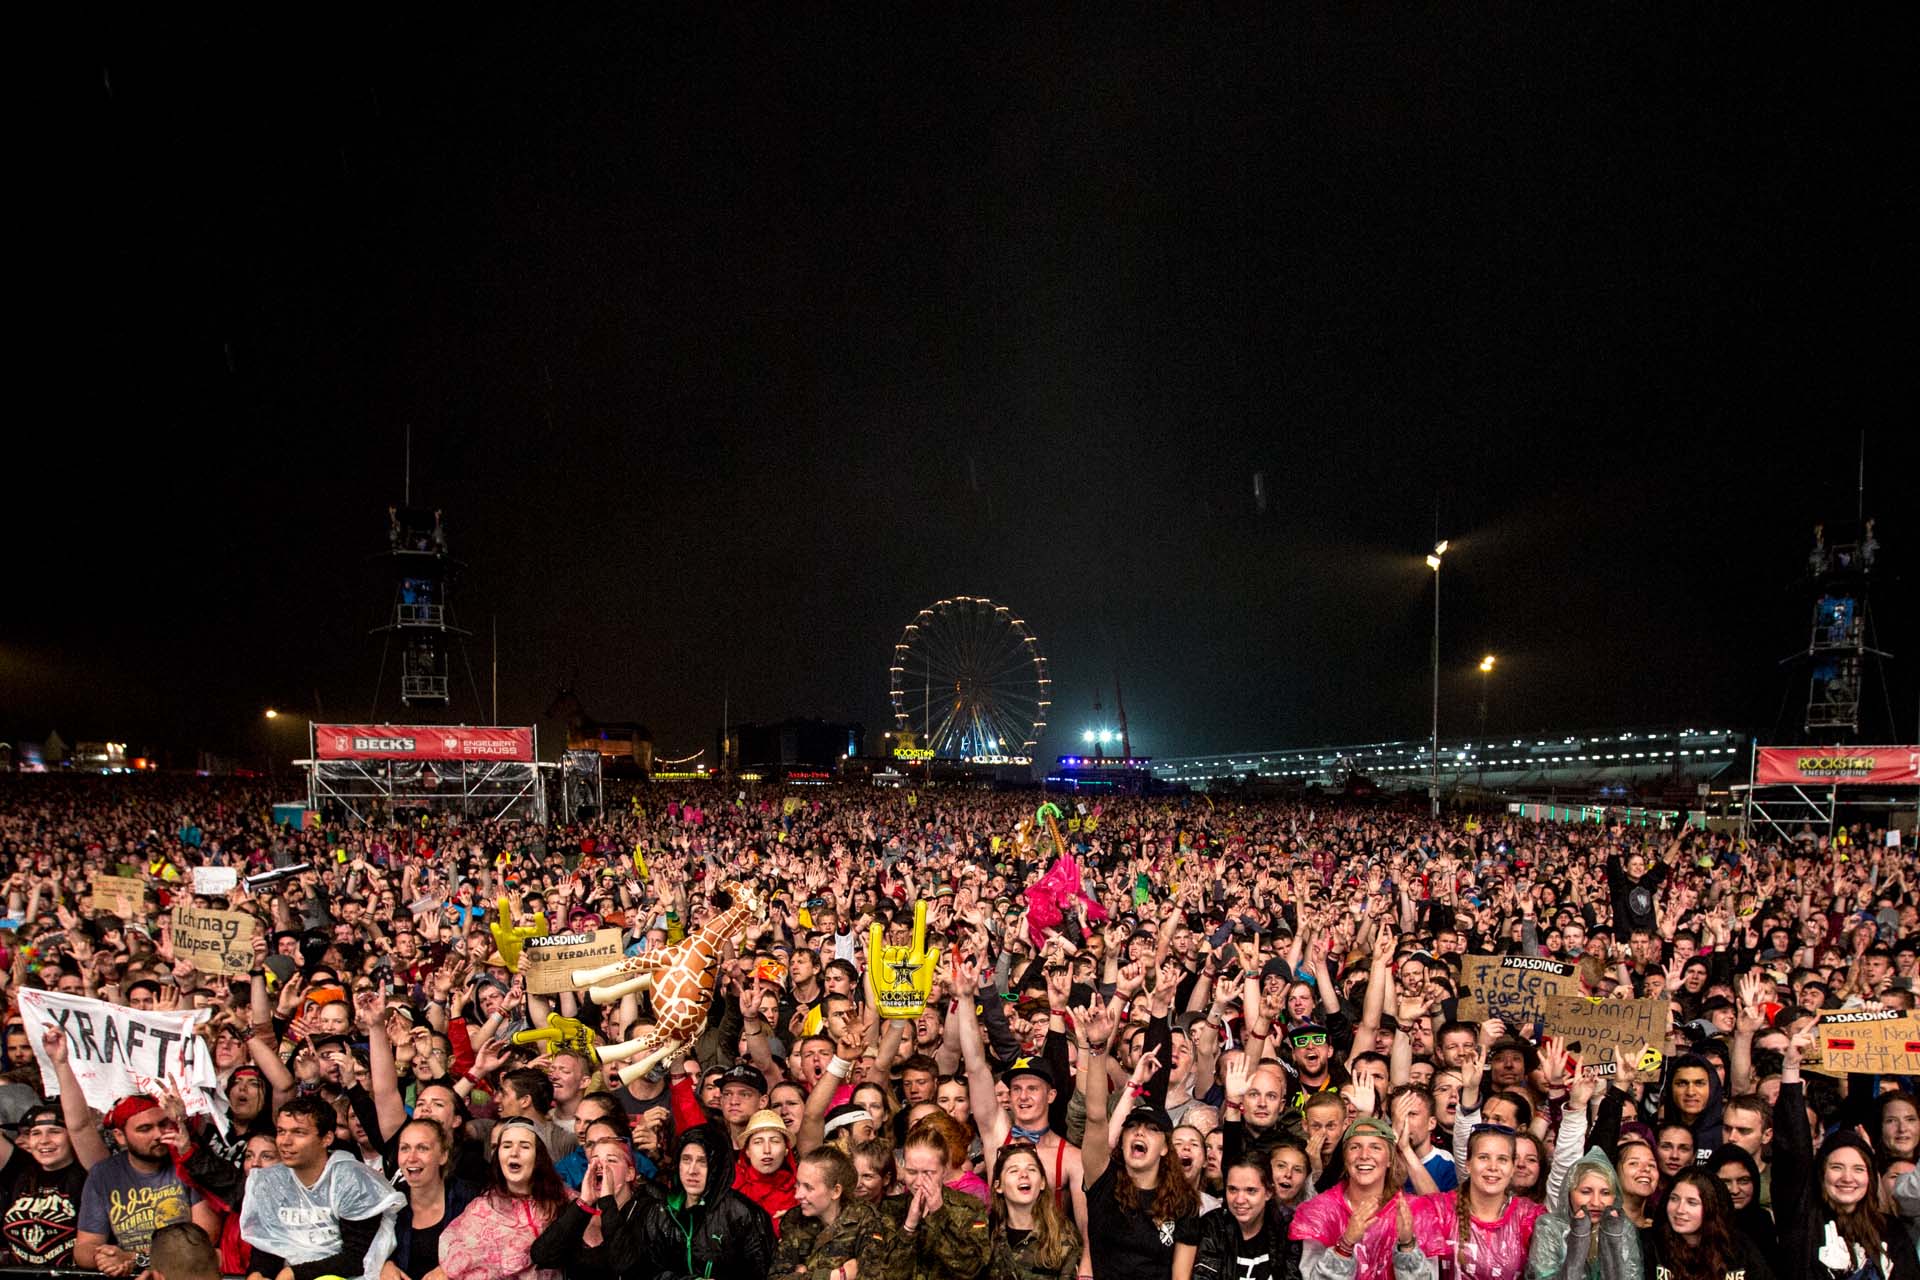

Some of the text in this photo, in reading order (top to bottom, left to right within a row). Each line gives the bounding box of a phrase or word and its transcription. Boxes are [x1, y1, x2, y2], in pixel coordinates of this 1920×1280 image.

[355, 738, 415, 750] BECK'S
[178, 907, 239, 940] Ich mag
[540, 934, 586, 946] DASDING
[1512, 958, 1563, 974] DASDING
[1474, 964, 1558, 996] Ficken
[1474, 987, 1535, 1008] gegen
[1836, 1009, 1899, 1023] DASDING
[1586, 1043, 1614, 1062] Du
